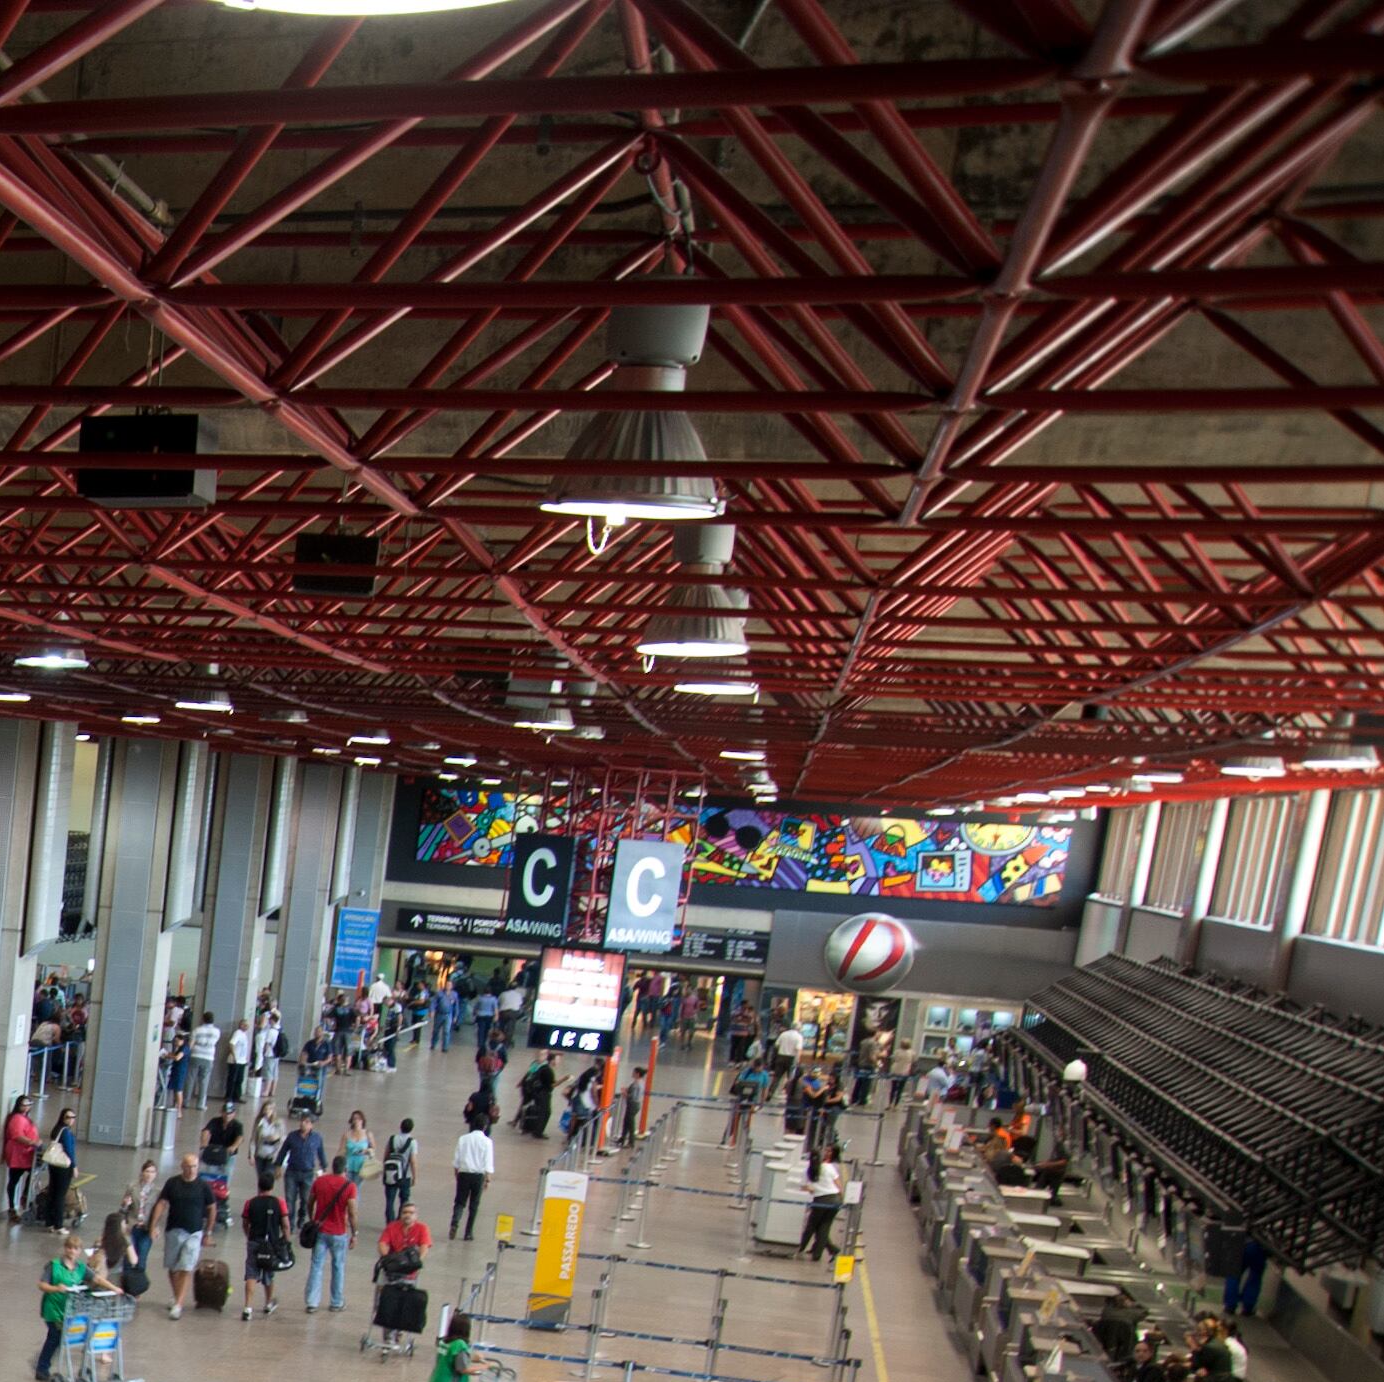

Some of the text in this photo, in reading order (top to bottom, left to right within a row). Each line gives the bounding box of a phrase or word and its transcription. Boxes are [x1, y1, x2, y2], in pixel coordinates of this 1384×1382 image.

[522, 847, 557, 907] C
[626, 856, 666, 917] C
[426, 914, 462, 925] TERMINAL
[505, 918, 562, 938] ASA/WING
[607, 927, 672, 945] ASA/WING
[559, 1202, 581, 1280] PASSAREDO
